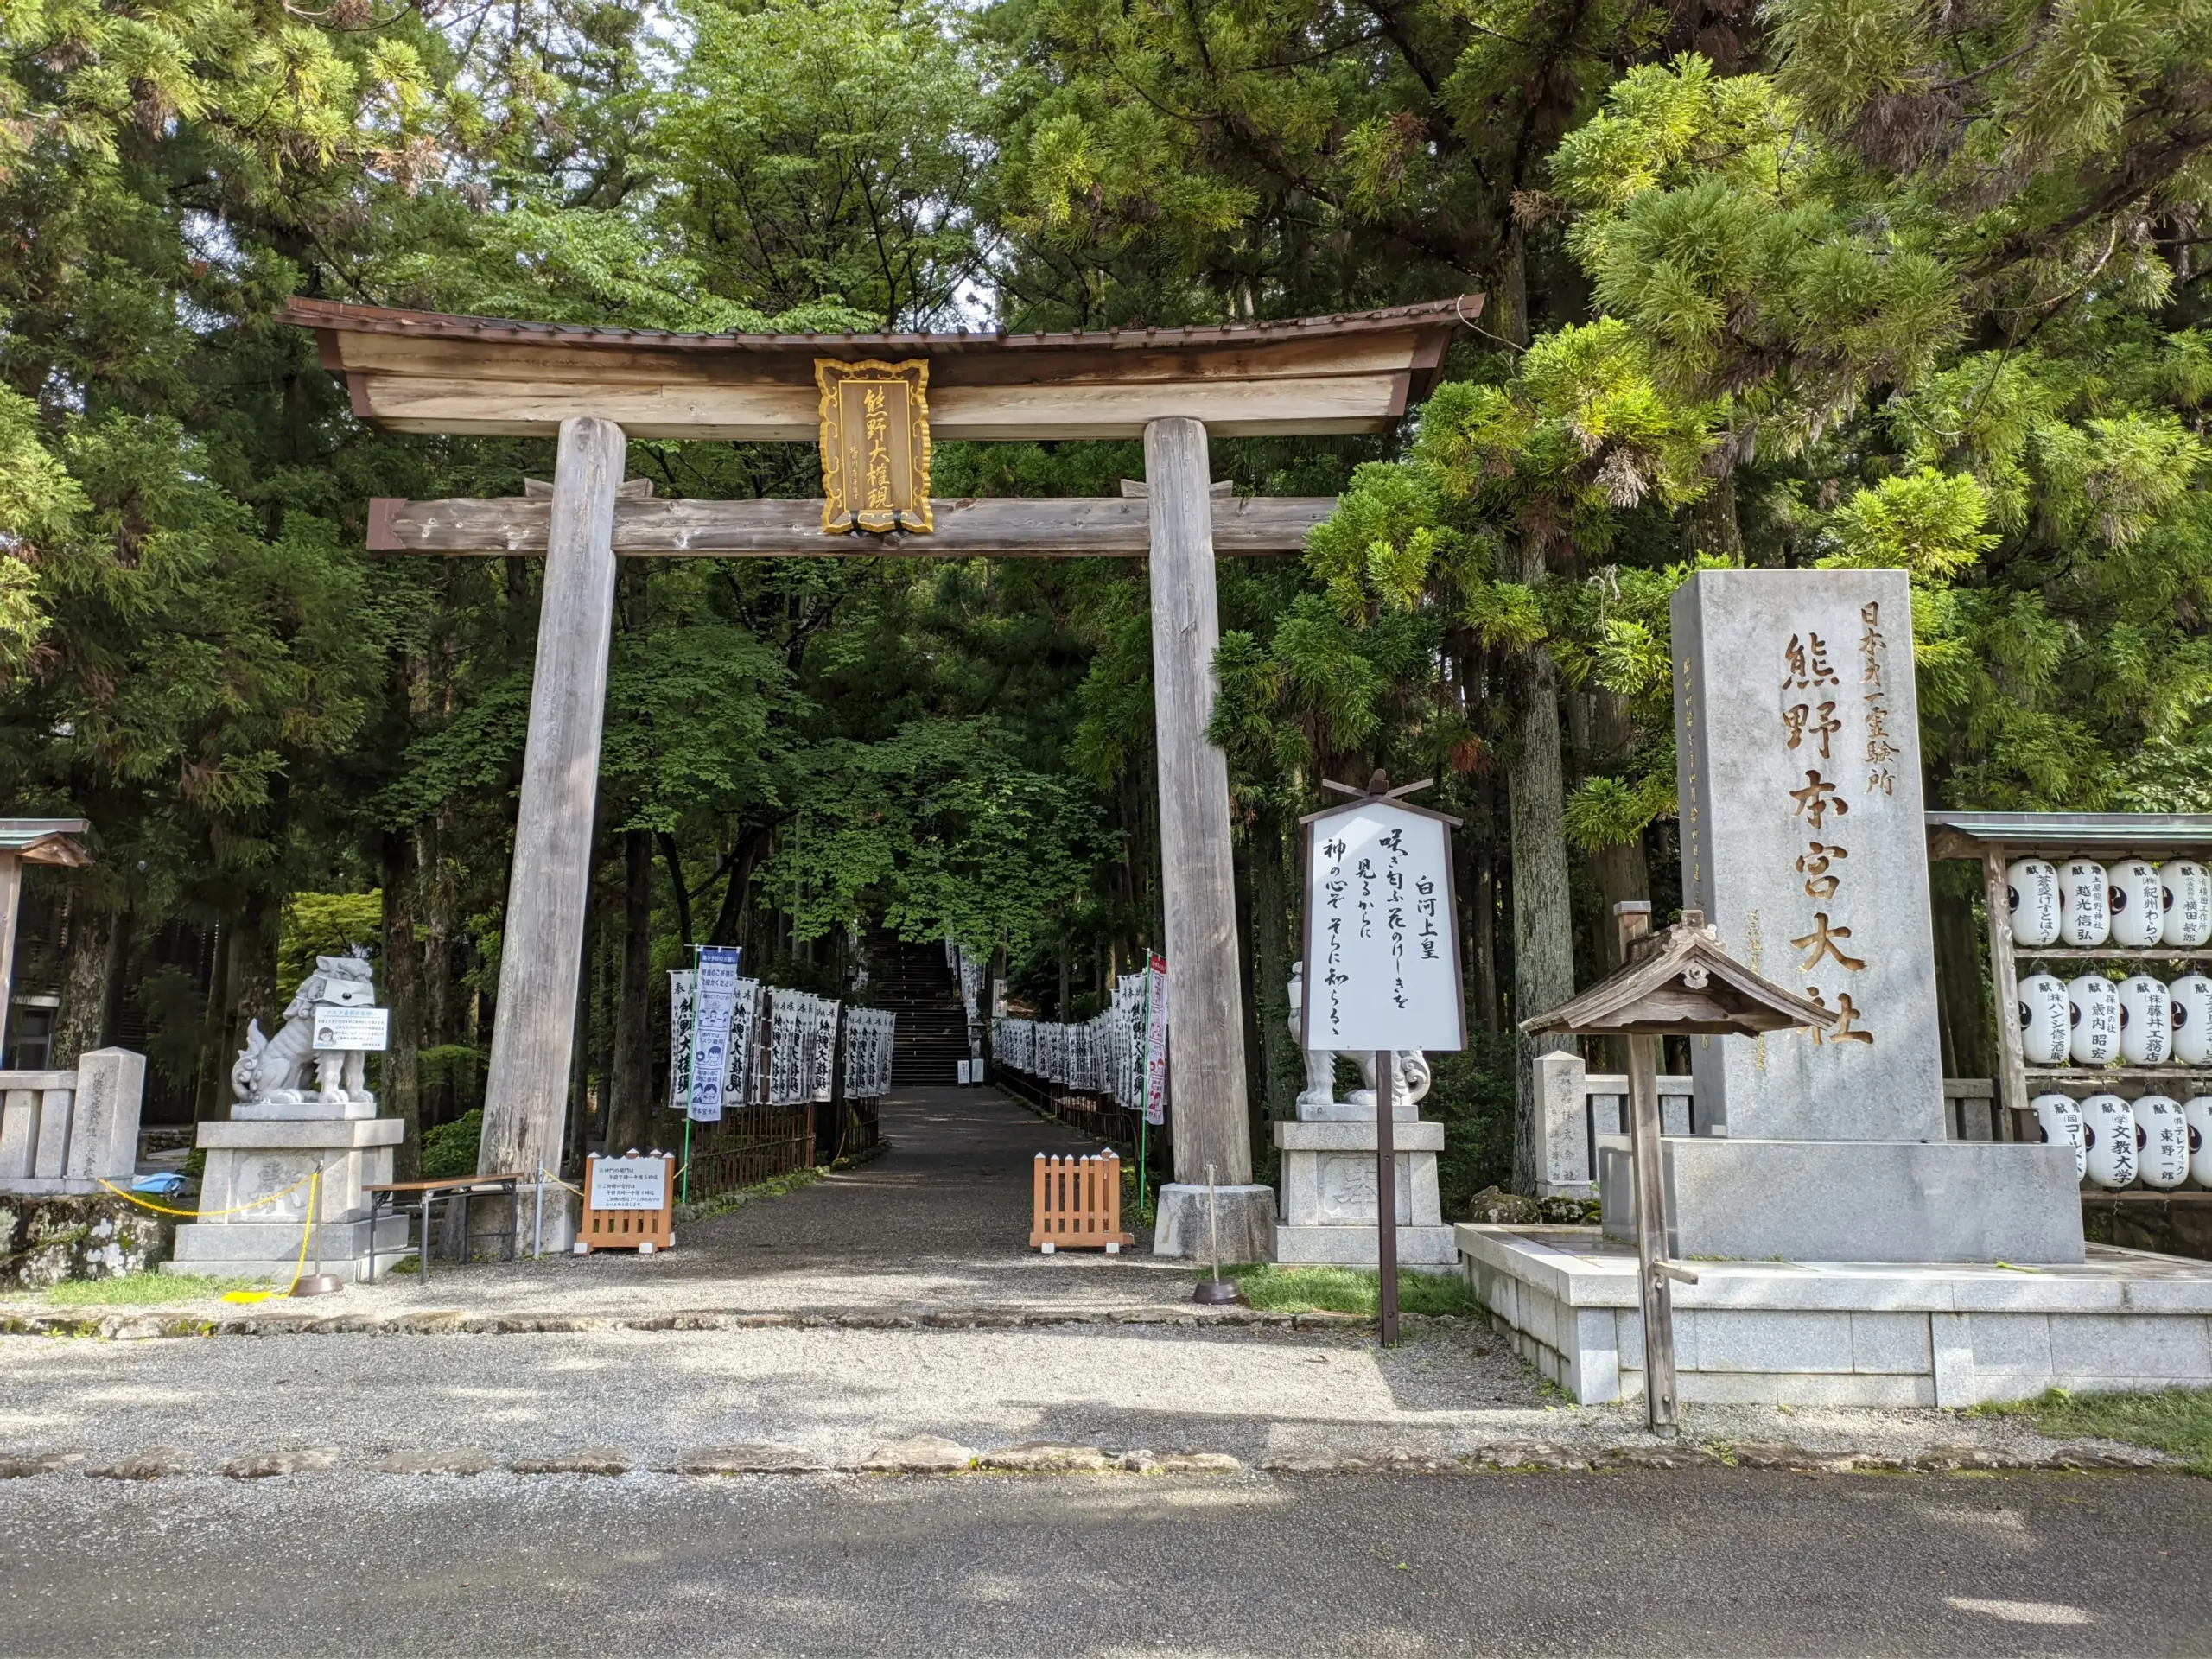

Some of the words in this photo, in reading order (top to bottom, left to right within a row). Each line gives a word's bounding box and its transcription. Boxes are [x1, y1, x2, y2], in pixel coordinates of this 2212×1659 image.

[1781, 632, 1873, 1046] 熊野本宮大社
[1356, 858, 1376, 939] 見るからに
[1379, 829, 1409, 1010] 咲き匂ふ花のけしきを
[1416, 874, 1440, 960] 白河上皇
[2075, 885, 2093, 941] 越光信弘
[2092, 876, 2103, 930] 土屋熊野神社
[2143, 994, 2164, 1062] (株)藤井工務店
[2111, 1115, 2133, 1185] (学)文教大学
